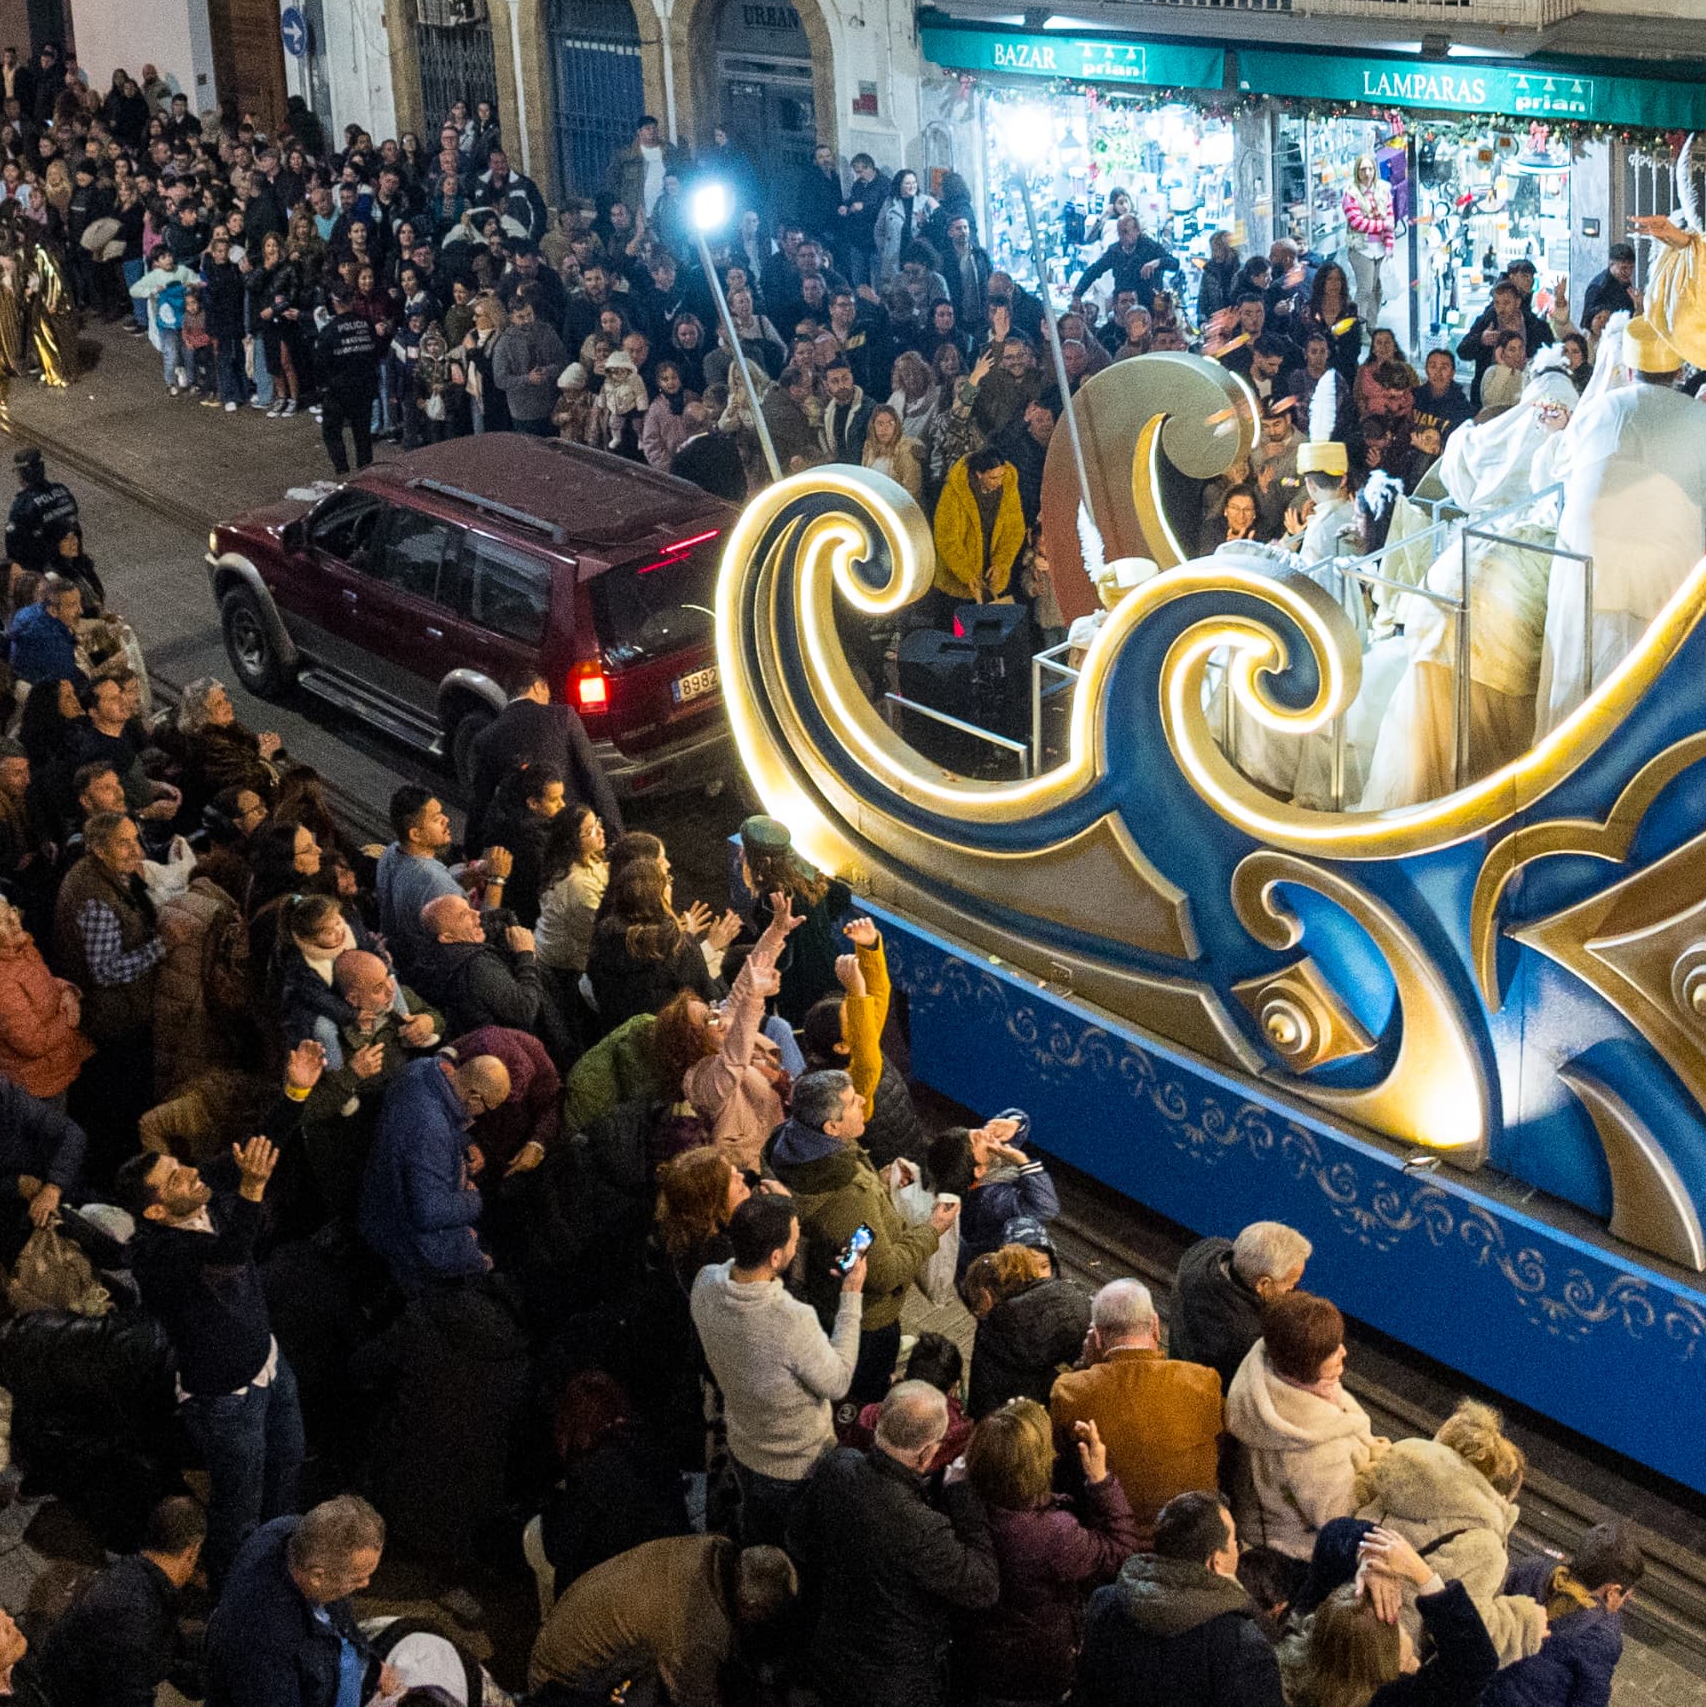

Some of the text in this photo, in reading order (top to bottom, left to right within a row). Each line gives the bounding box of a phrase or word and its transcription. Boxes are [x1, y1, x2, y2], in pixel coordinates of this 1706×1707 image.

[994, 44, 1140, 77] BAZAR prian
[1363, 71, 1585, 112] LAMPARAS prian
[682, 668, 718, 695] 8982
